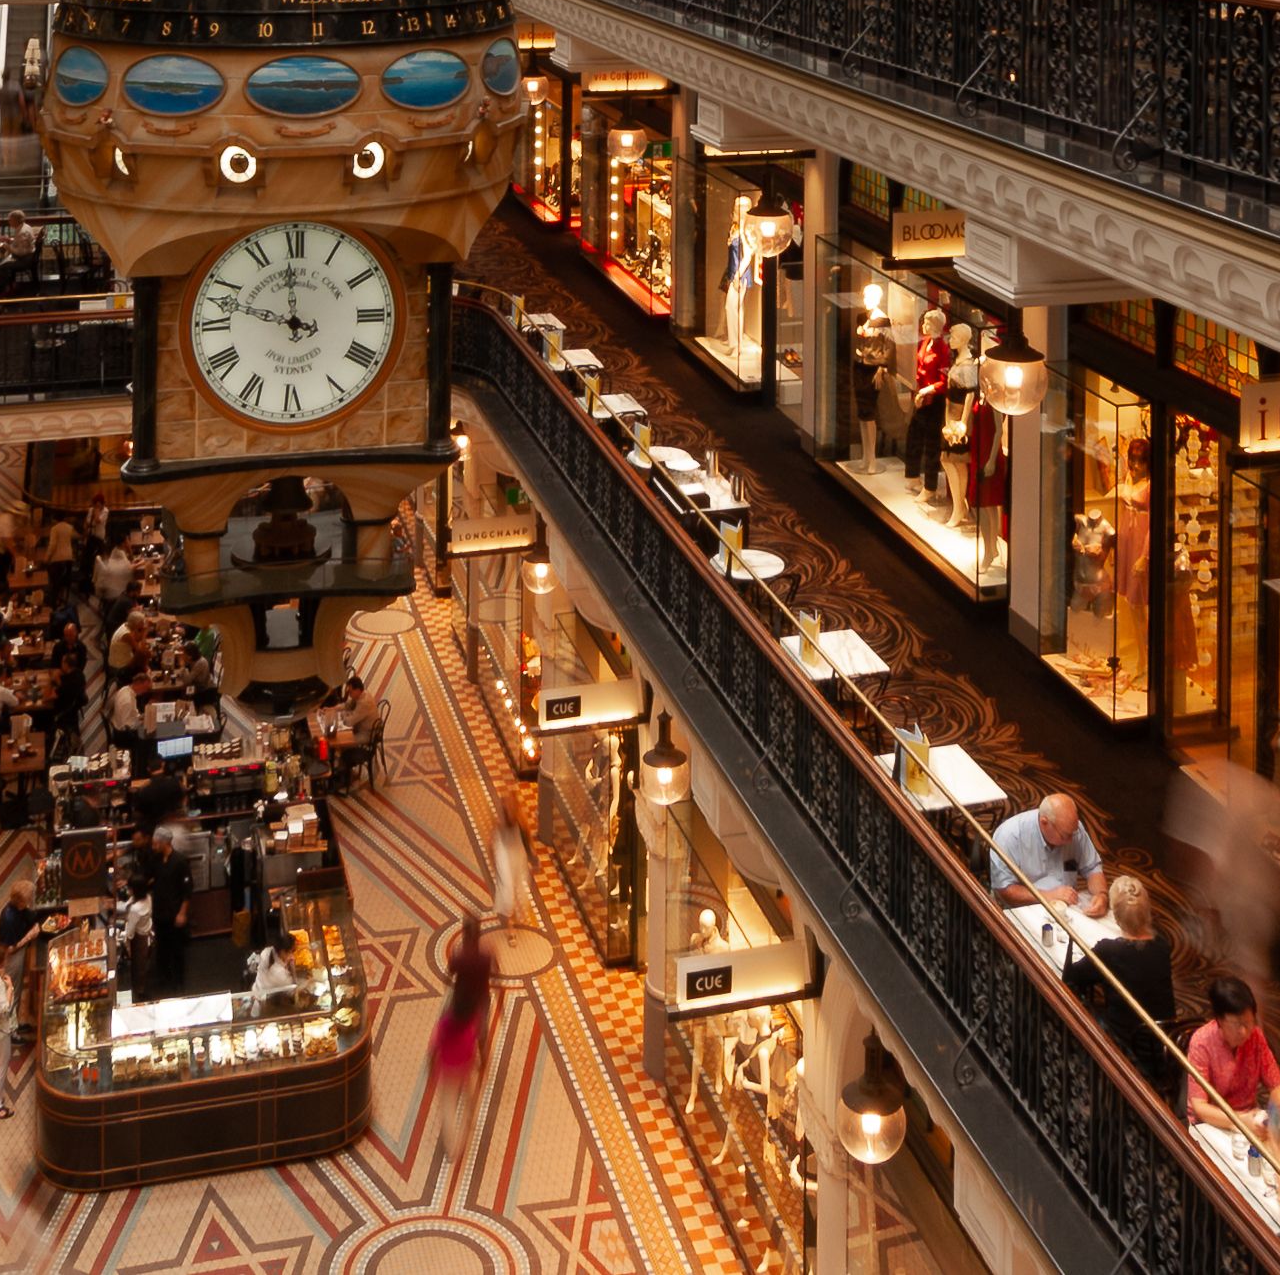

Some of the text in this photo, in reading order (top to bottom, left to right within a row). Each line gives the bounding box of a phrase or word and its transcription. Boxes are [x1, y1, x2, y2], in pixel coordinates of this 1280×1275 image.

[121, 18, 130, 34] 7
[162, 21, 171, 37] 8
[209, 22, 219, 37] 9
[258, 22, 273, 38] 10
[311, 22, 323, 37] 11
[361, 20, 376, 35] 12
[407, 17, 420, 32] 13
[284, 231, 305, 258] XII
[312, 270, 320, 279] C
[322, 276, 344, 301] COOK
[345, 266, 375, 290] II
[356, 306, 386, 324] III
[287, 347, 321, 364] LIMITED
[273, 364, 313, 375] SYDNEY
[459, 527, 529, 542] LONGCHAMP
[552, 702, 575, 715] CUE
[695, 974, 723, 991] CUE
